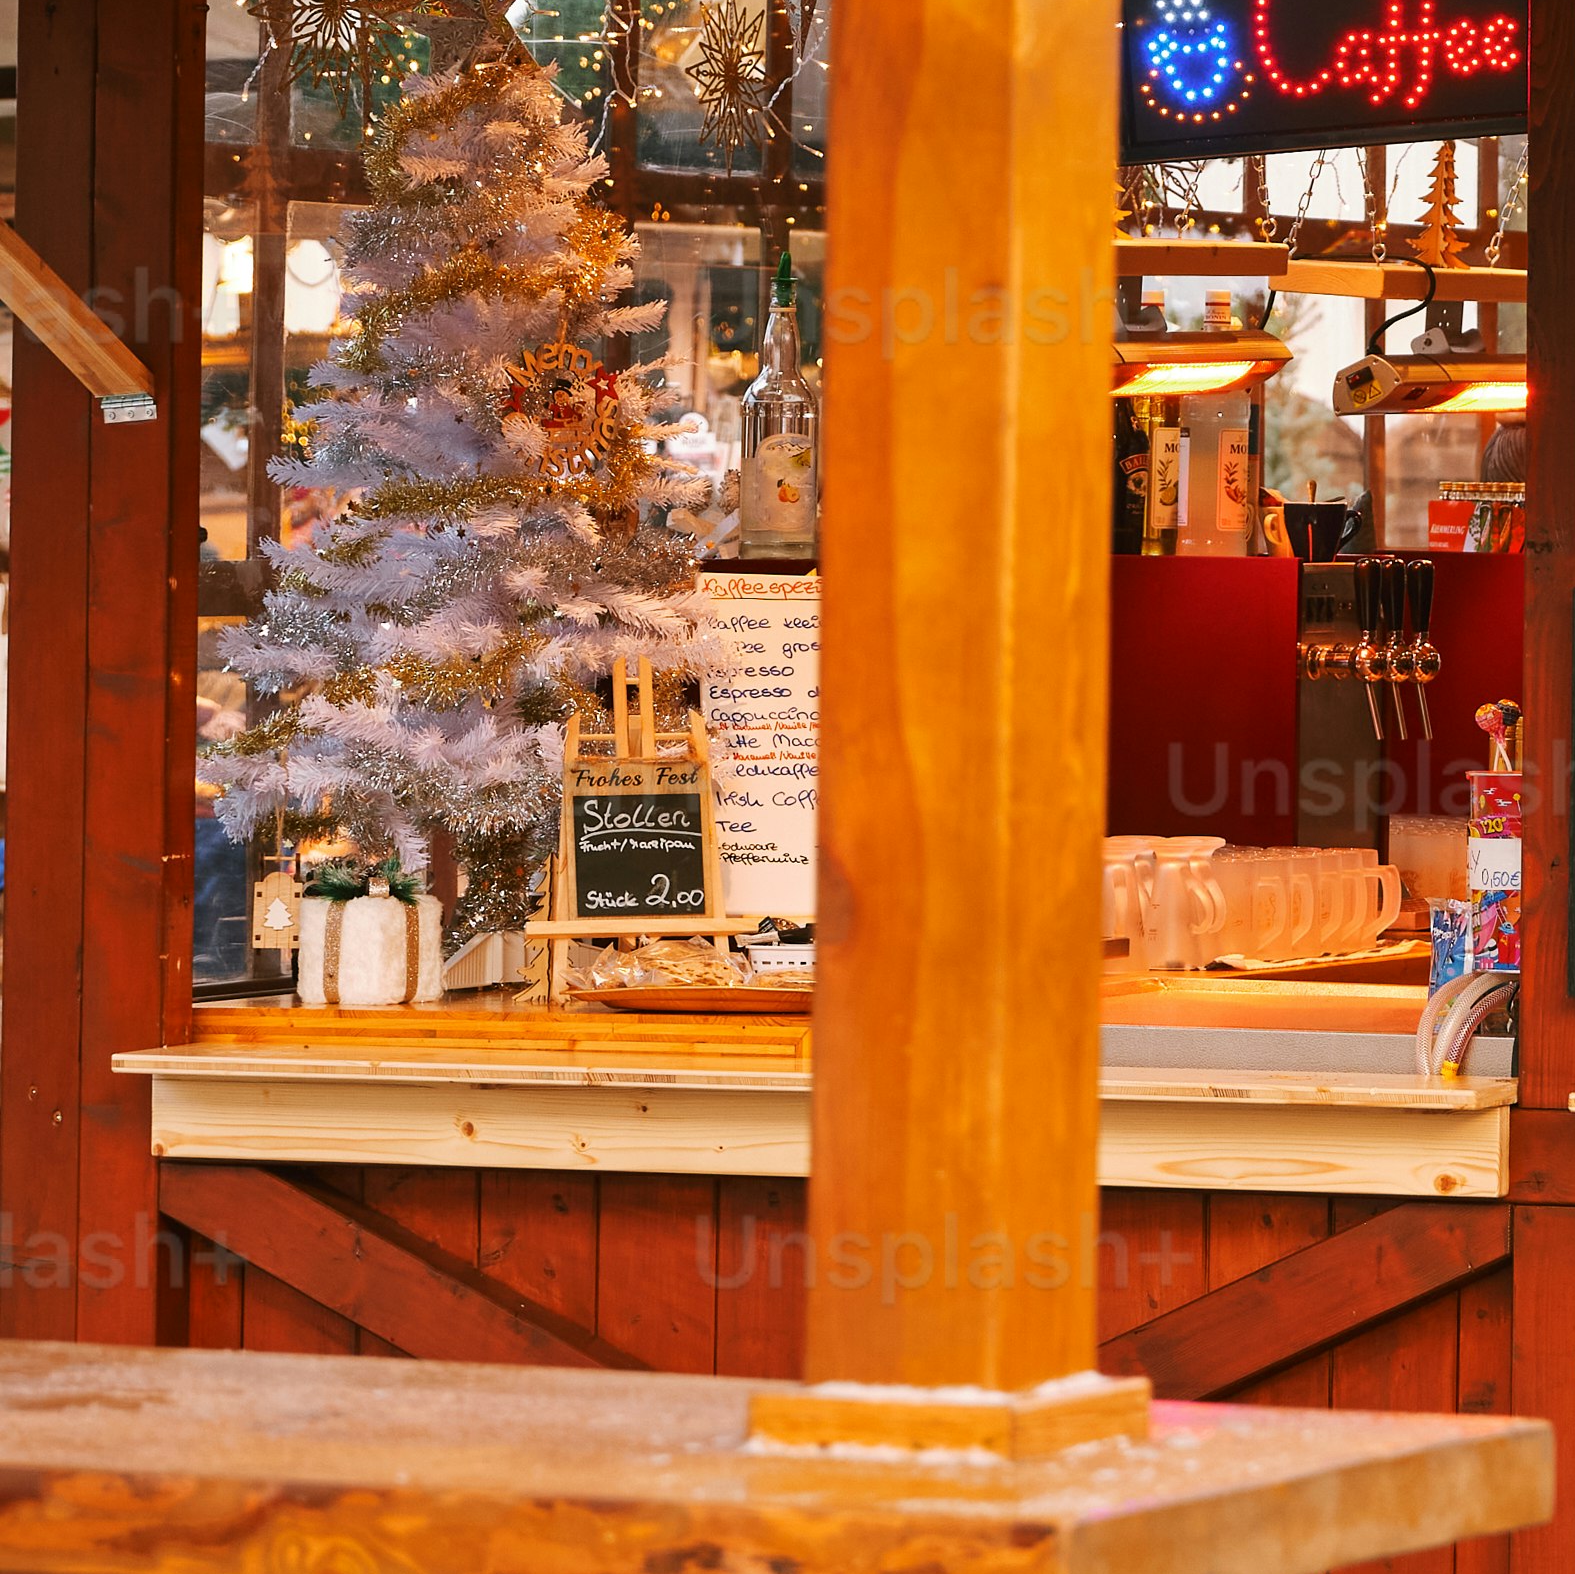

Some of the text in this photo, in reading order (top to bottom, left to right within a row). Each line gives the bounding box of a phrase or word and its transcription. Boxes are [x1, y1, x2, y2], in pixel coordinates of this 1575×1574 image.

[575, 765, 700, 788] Frohes Fest
[583, 799, 691, 835] Stollen
[715, 820, 758, 834] Tee
[584, 873, 705, 910] Stück 2,00
